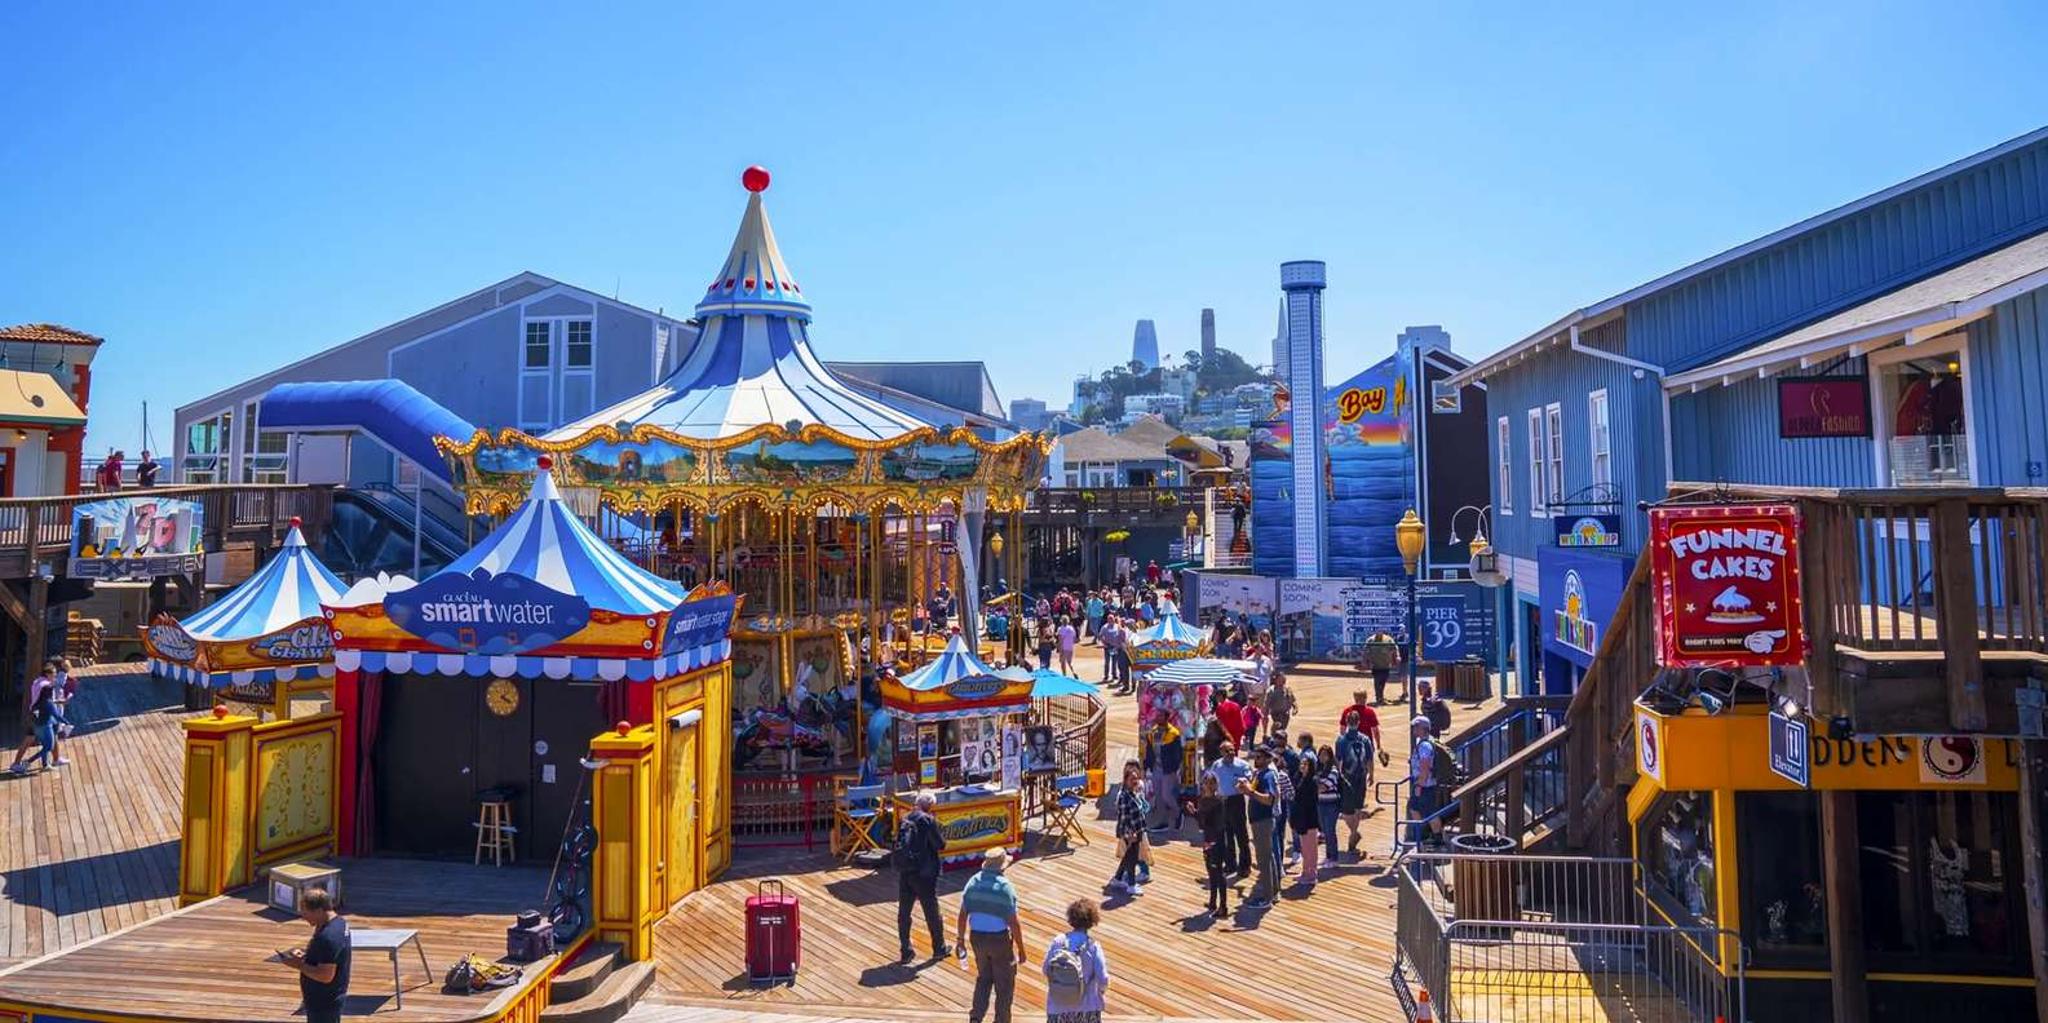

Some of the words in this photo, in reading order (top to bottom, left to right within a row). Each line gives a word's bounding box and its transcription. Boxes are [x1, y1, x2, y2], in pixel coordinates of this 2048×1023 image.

[1338, 387, 1385, 422] Bay
[1560, 534, 1618, 546] WORKSHOP
[1669, 528, 1787, 558] FUNNEL
[1691, 556, 1774, 581] CAKES
[1283, 594, 1309, 602] SOON
[1284, 583, 1322, 592] COMING
[422, 599, 554, 624] smartwater
[1426, 607, 1458, 619] PIER
[291, 624, 335, 648] GIA
[1426, 620, 1461, 648] 39
[1814, 736, 1903, 766] DDEN
[1775, 754, 1801, 779] Elevator
